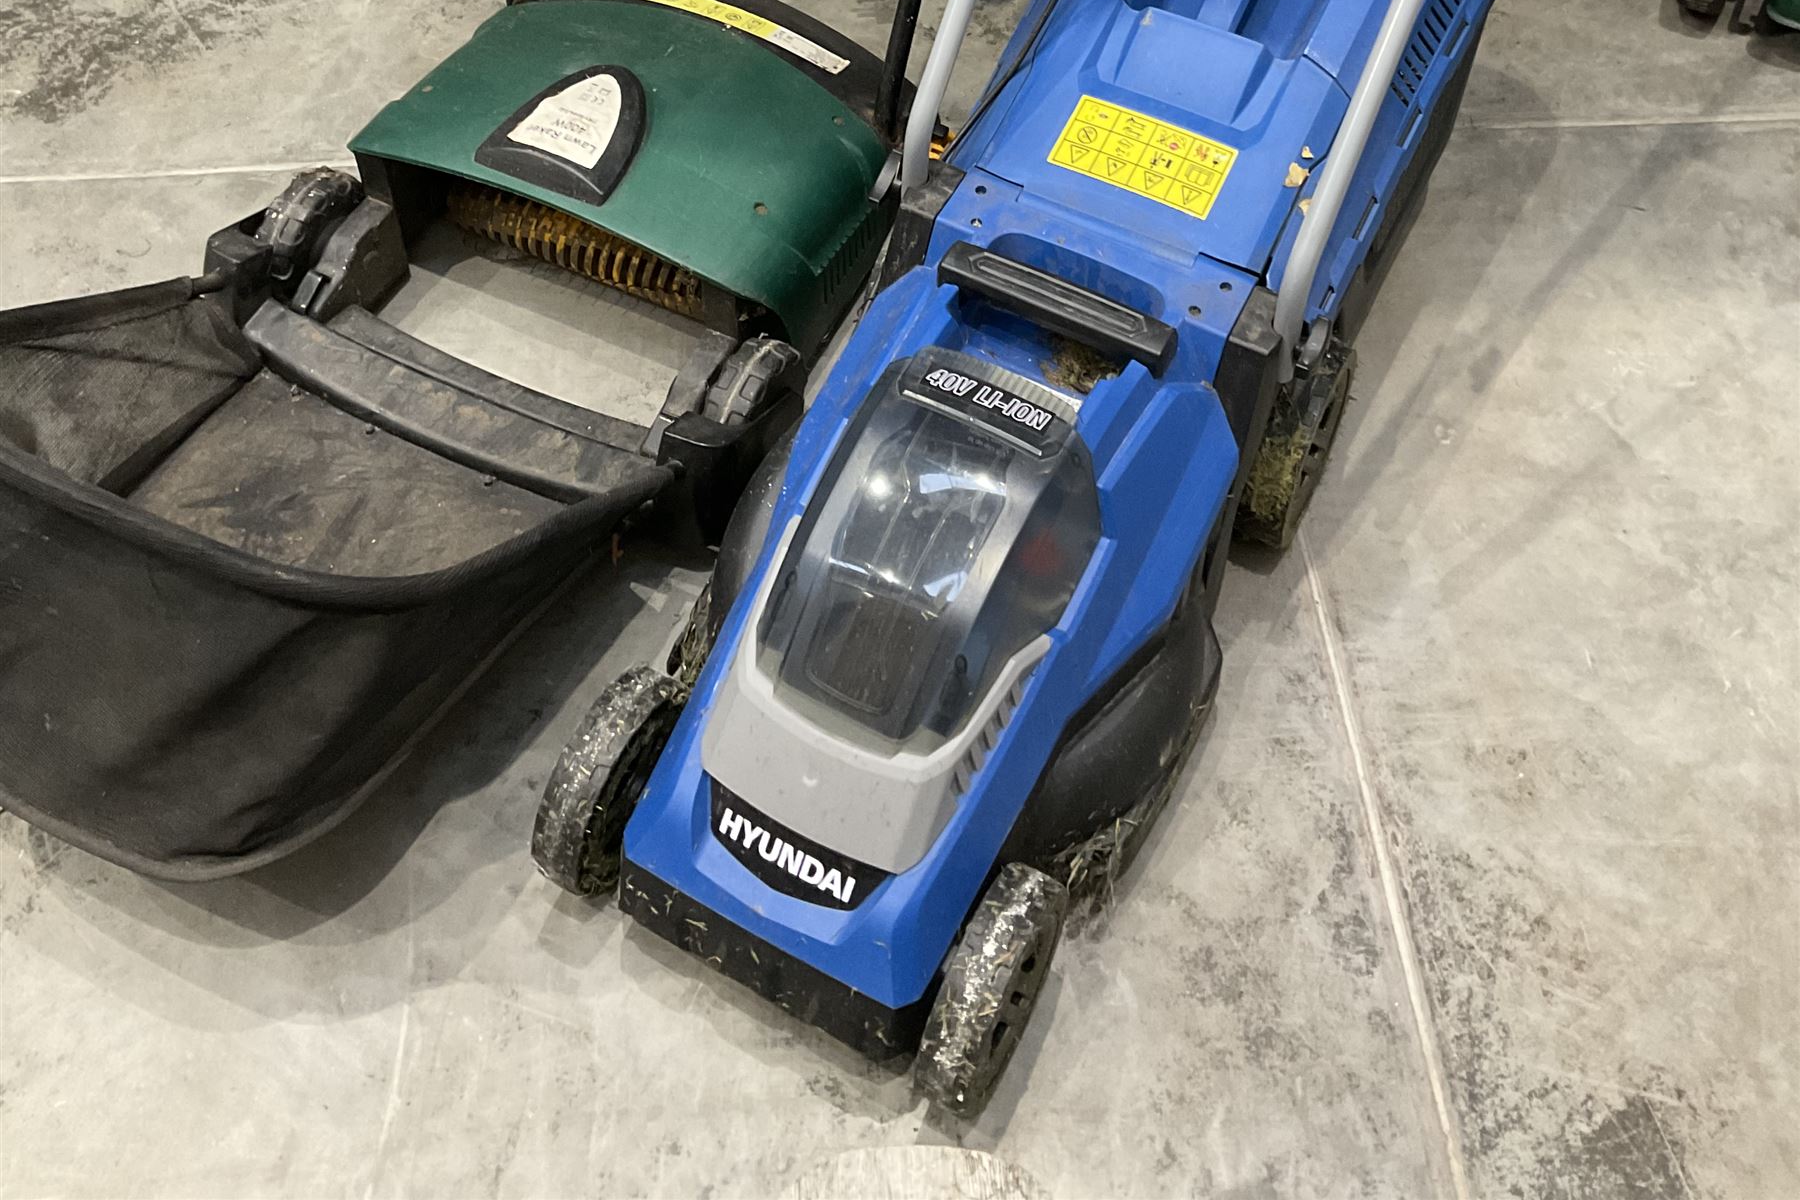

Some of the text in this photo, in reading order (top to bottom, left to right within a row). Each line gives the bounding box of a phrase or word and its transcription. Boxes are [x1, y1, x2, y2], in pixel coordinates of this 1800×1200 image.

[563, 133, 597, 156] Lawn
[926, 369, 1053, 431] 40V LI-ION
[719, 807, 856, 903] HYUNDAI
